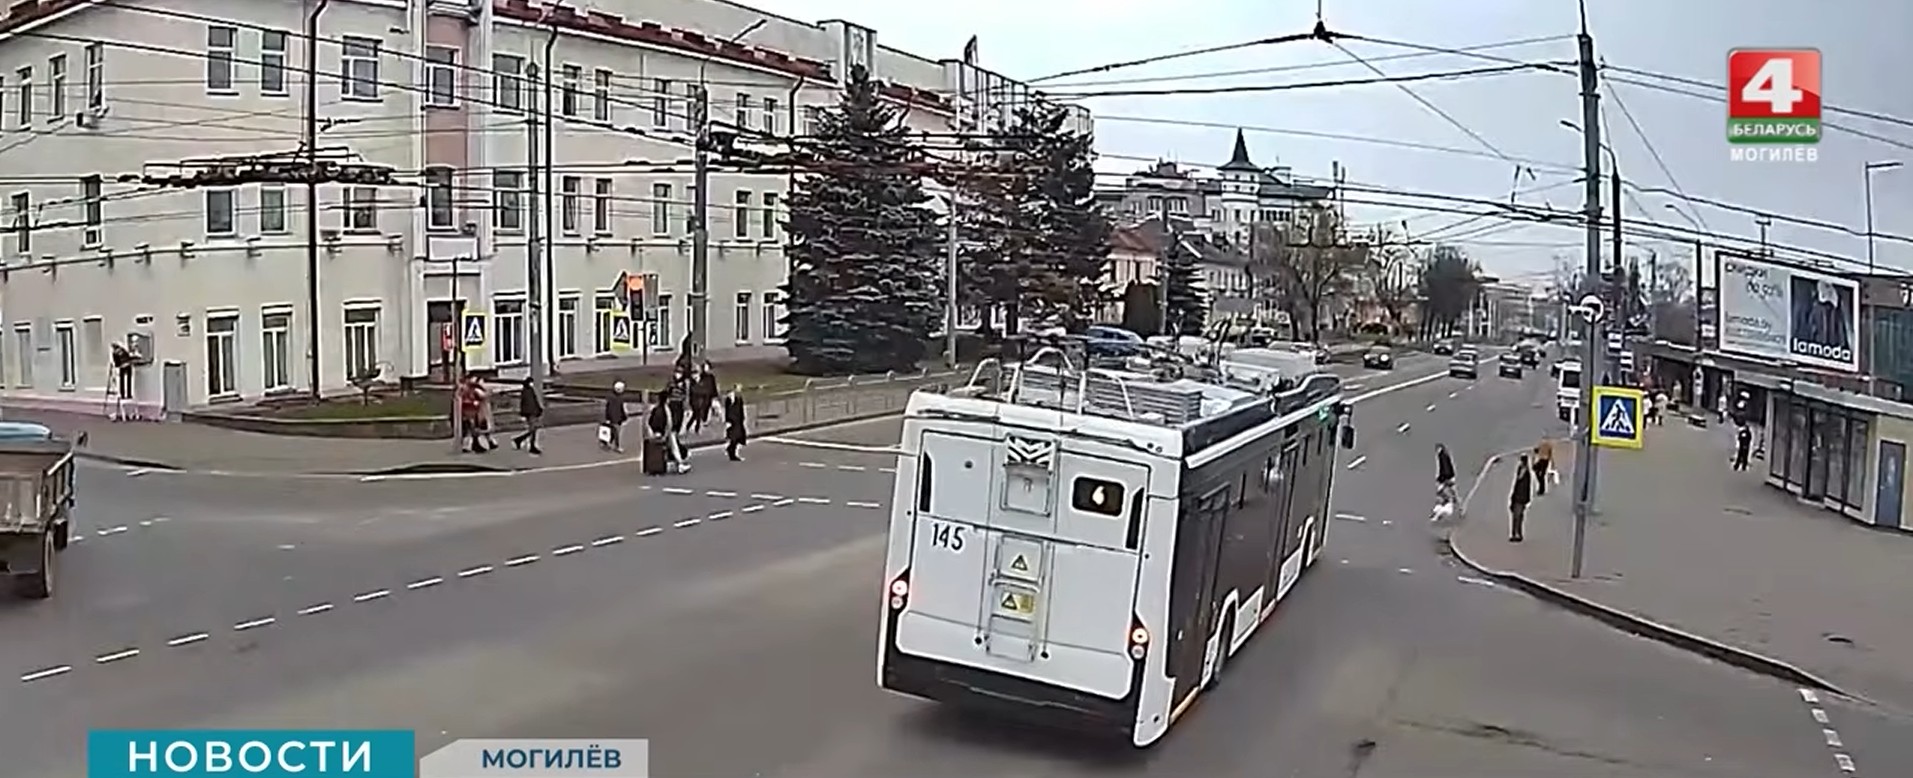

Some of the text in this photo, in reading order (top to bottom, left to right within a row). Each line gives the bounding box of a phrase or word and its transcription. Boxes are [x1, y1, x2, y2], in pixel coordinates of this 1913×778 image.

[1793, 338, 1851, 360] lamoda
[1092, 486, 1105, 505] 6
[931, 523, 965, 551] 145
